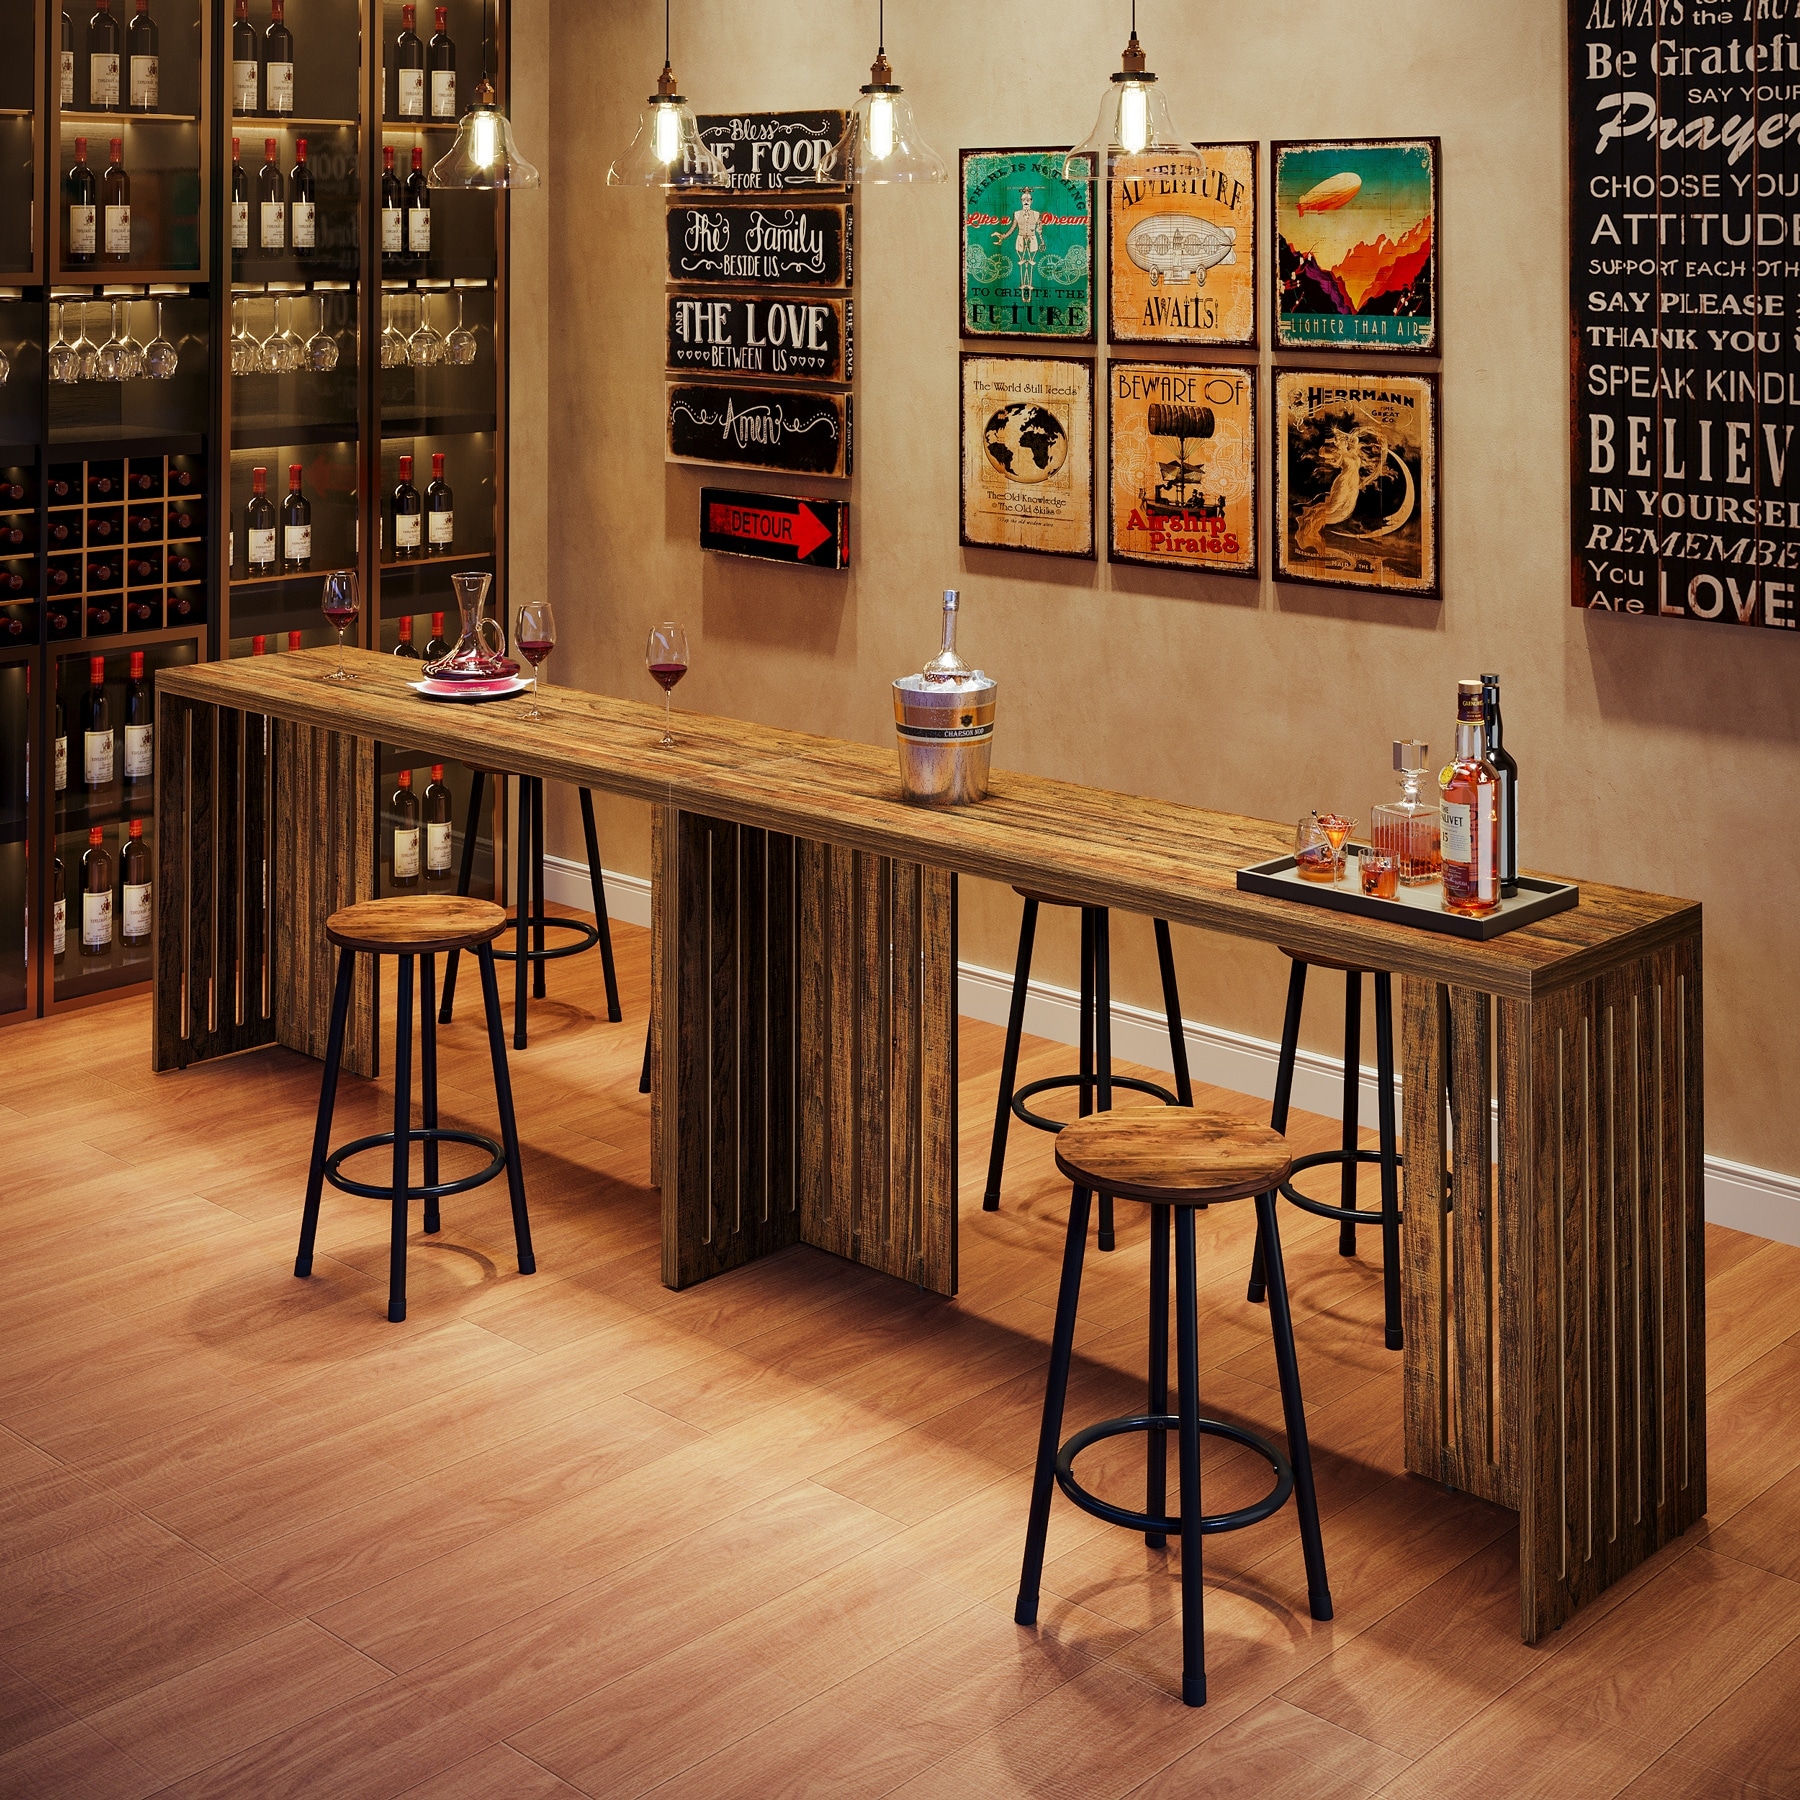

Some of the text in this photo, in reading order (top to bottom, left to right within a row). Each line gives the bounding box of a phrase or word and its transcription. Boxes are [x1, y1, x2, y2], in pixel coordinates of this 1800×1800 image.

[1585, 0, 1684, 29] ALWAYS
[1692, 10, 1733, 26] the
[1585, 43, 1637, 79] Be
[1687, 87, 1733, 103] SAY
[729, 119, 779, 142] Bless
[683, 143, 735, 174] THE
[752, 140, 837, 173] FOOD
[725, 173, 762, 189] BEFORE
[1011, 164, 1026, 172] IS
[1032, 164, 1086, 211] NOTHING
[1122, 162, 1244, 213] ADVENTURE
[1590, 174, 1720, 198] CHOOSE
[966, 212, 1089, 228] Like a Dream
[685, 209, 823, 267] The Family
[724, 255, 760, 277] BESIDE
[1588, 259, 1679, 277] SUPPORT
[1686, 261, 1747, 278] EACH
[972, 287, 1085, 299] TO CREATE THE
[1587, 291, 1785, 316] SAY PLEASE
[972, 302, 1084, 327] FUTURE
[1143, 292, 1219, 329] AWAITS!
[676, 301, 829, 351] THE LOVE
[1291, 318, 1419, 336] LIGHTER THAN AIR
[1586, 326, 1781, 353] THANK YOU
[711, 347, 788, 371] BETWEEN US
[973, 381, 991, 391] The
[993, 382, 1022, 393] World
[1024, 384, 1043, 394] Still
[1119, 375, 1244, 405] BEWARE OF
[1588, 364, 1696, 400] SPEAK
[1308, 387, 1414, 417] HERRMANN
[1588, 413, 1795, 487] BELIEV
[998, 503, 1013, 512] The
[1015, 504, 1031, 513] Old
[1004, 492, 1020, 501] Old
[1022, 494, 1067, 508] Knowledge
[1590, 486, 1627, 513] IN
[732, 510, 792, 540] DETOUR
[1126, 508, 1227, 538] Airship
[1588, 560, 1644, 586] You
[1588, 571, 1796, 628] Are LOVE
[1440, 813, 1464, 827] NLIVET
[1442, 831, 1449, 842] 15
